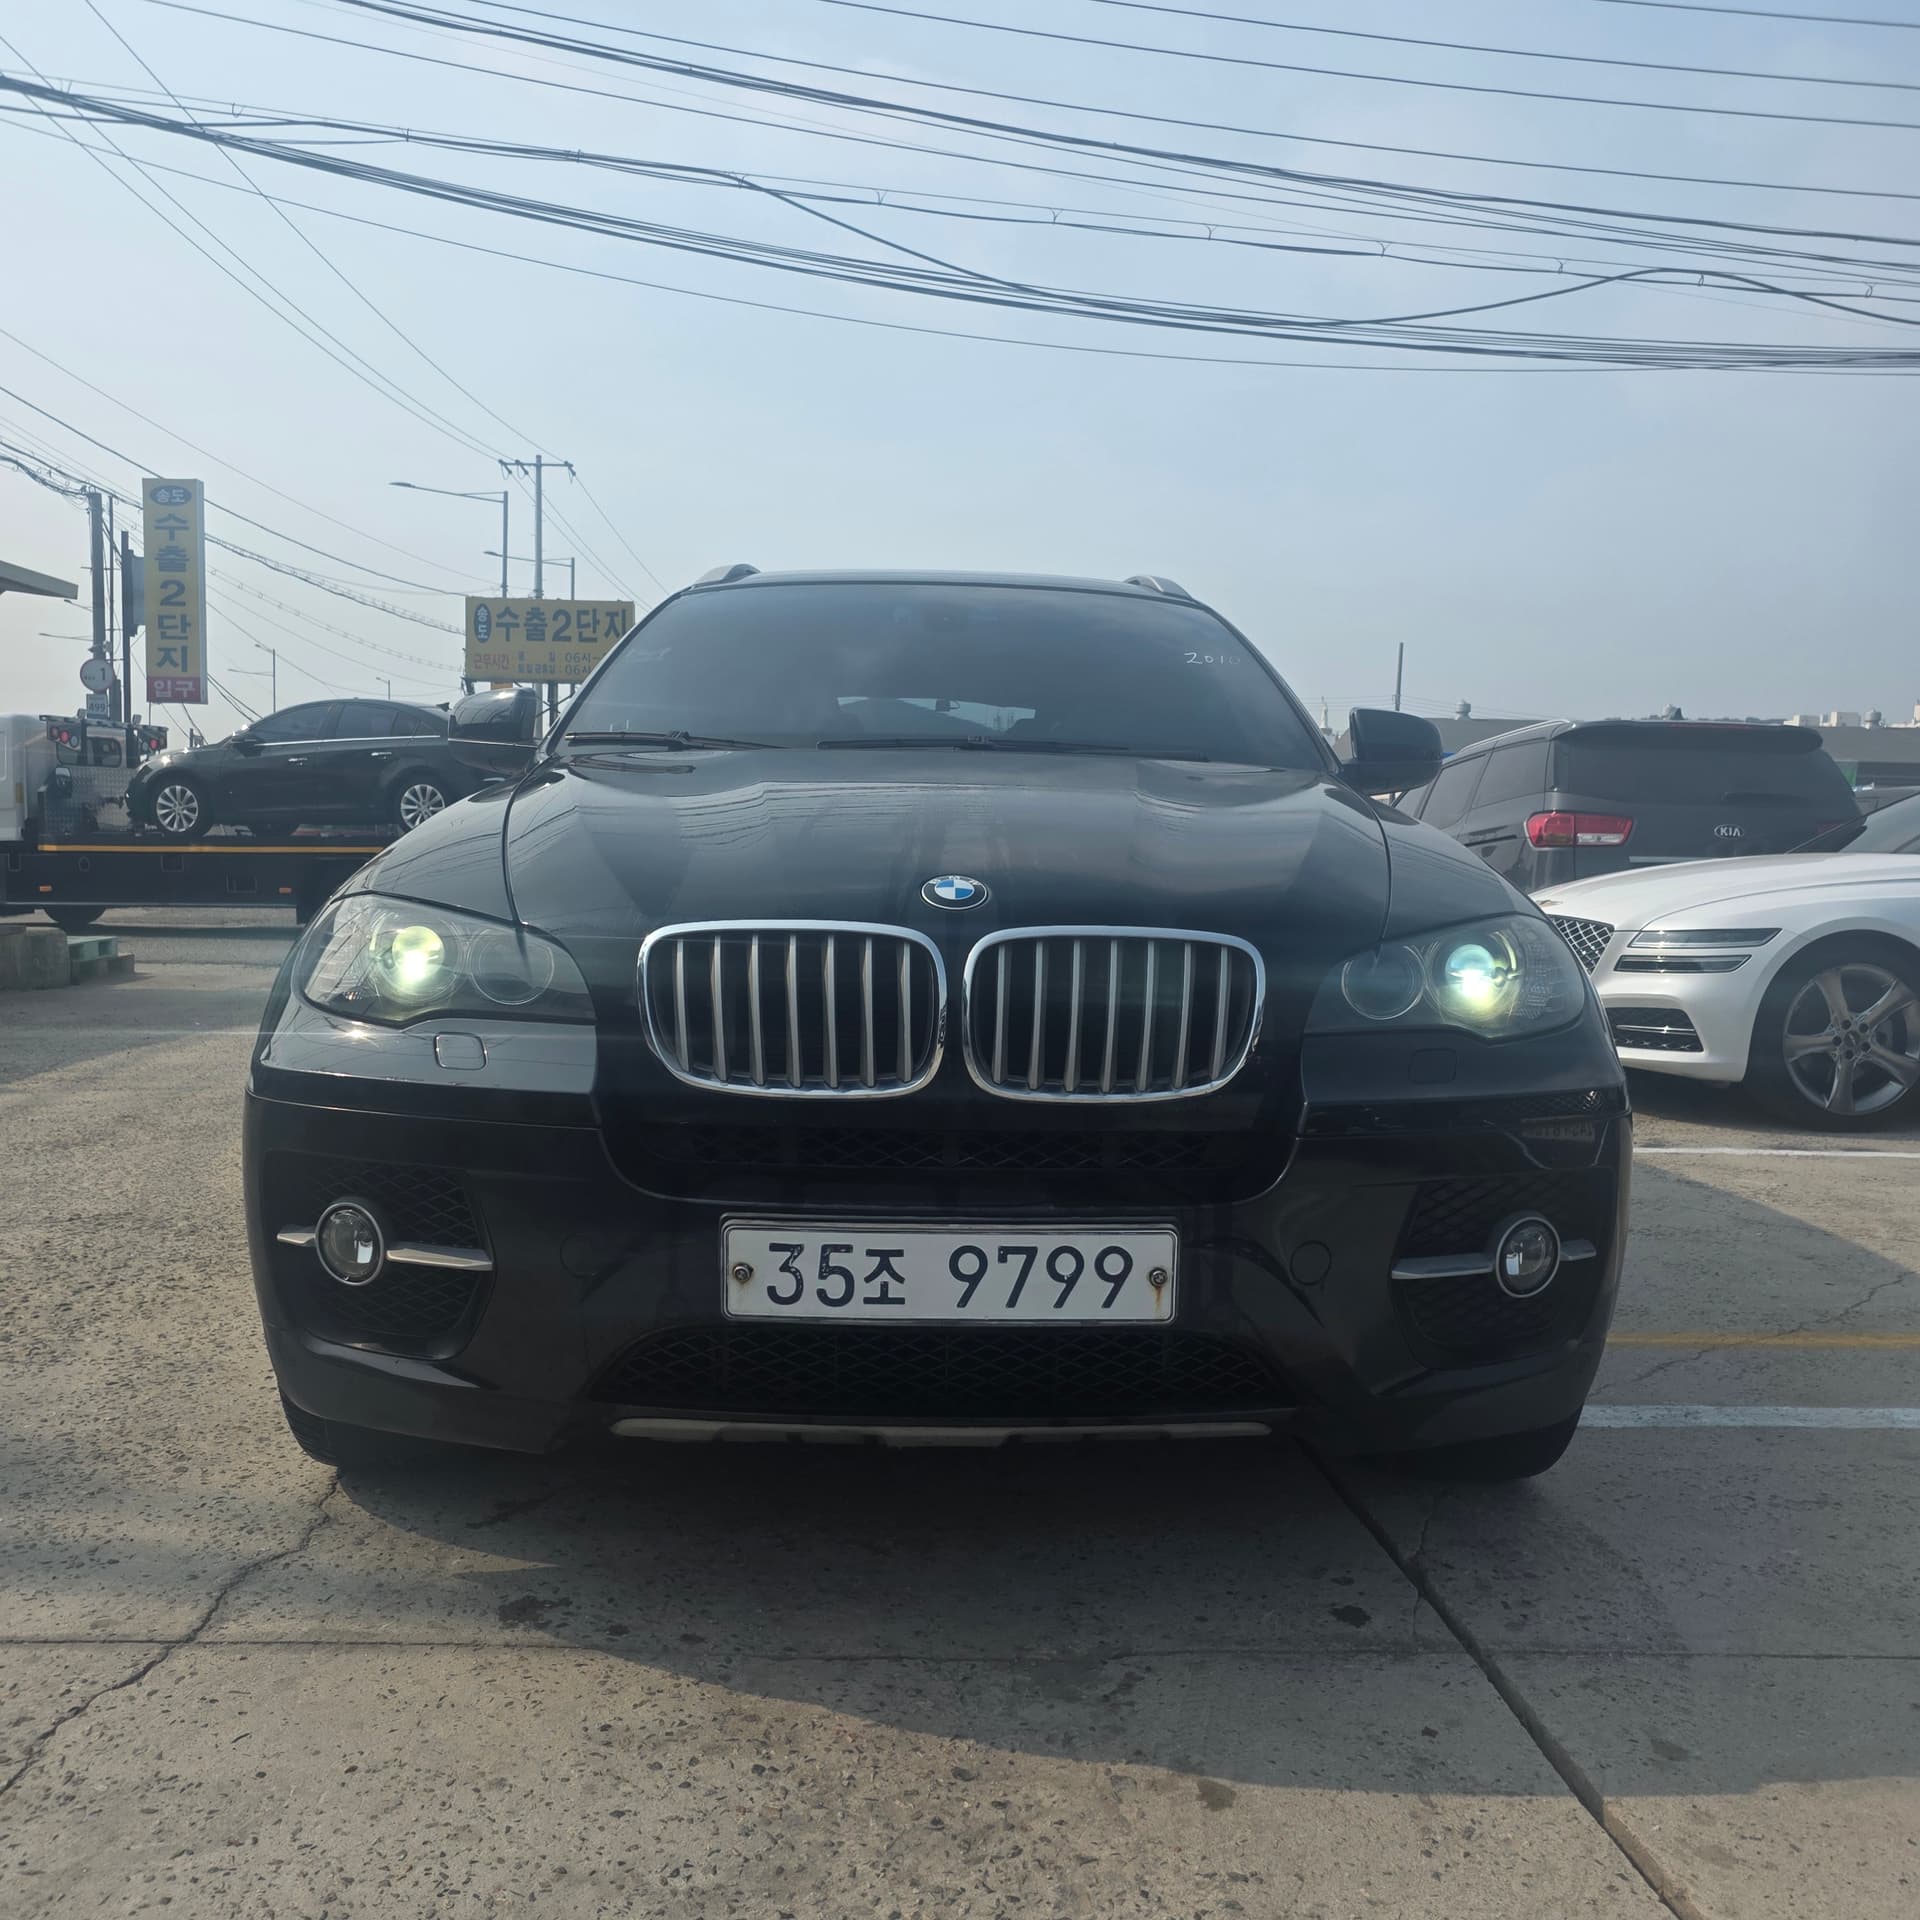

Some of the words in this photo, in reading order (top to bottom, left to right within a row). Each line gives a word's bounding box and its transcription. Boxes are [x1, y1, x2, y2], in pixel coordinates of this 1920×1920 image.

[155, 489, 185, 504] 송도
[154, 512, 192, 673] 수출2단지
[495, 606, 627, 643] 수출2단지
[153, 679, 196, 698] 입구
[1720, 827, 1741, 837] KIA
[766, 1242, 906, 1307] 35조
[948, 1244, 1134, 1309] 9799
